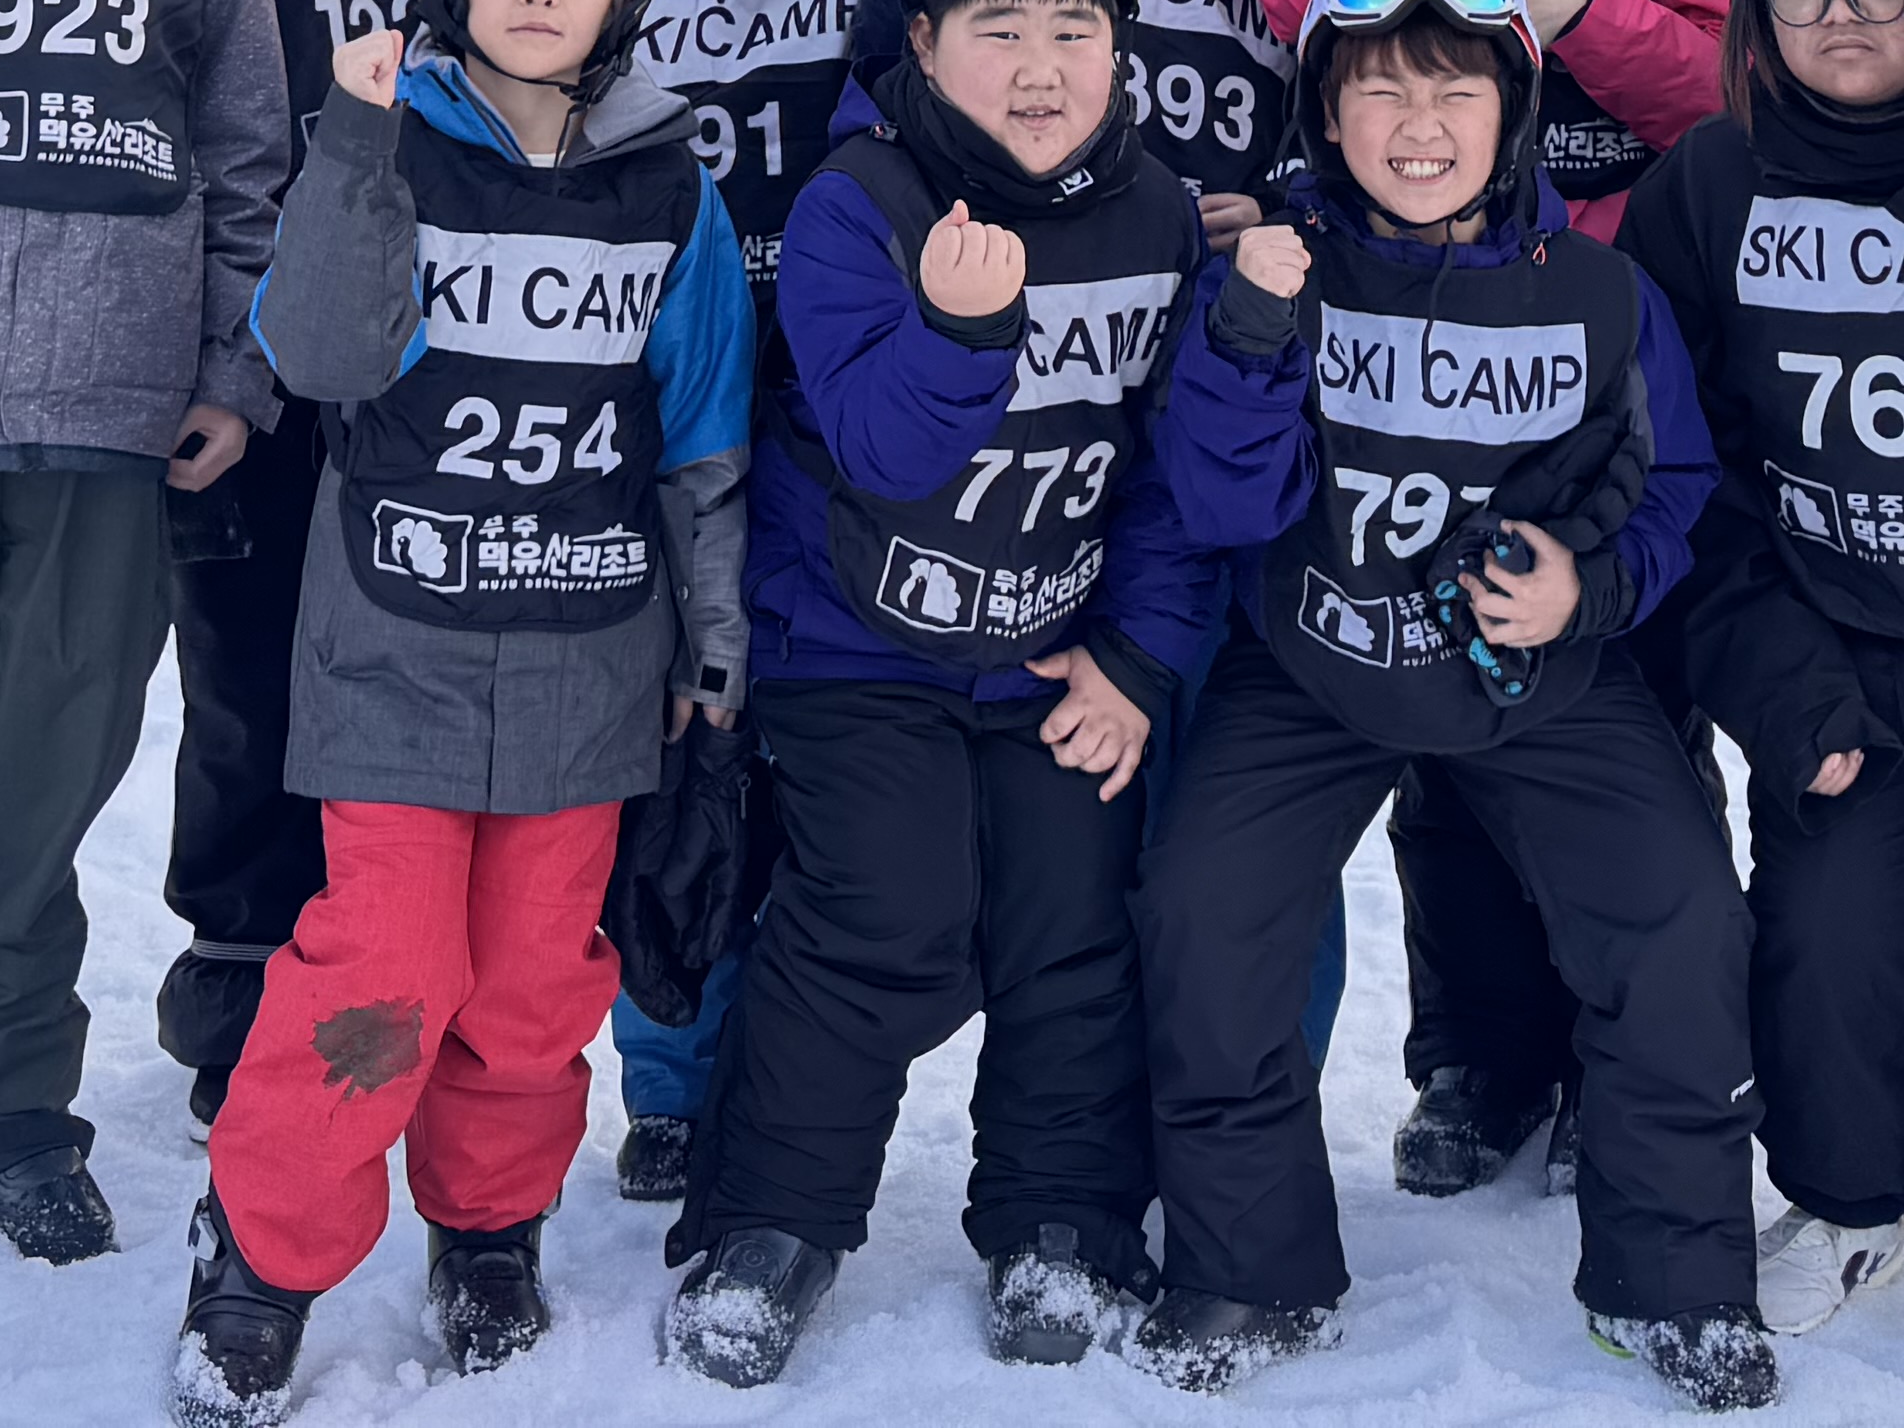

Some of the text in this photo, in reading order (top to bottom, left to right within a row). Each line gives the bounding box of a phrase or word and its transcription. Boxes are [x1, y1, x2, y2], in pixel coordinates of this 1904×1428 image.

[39, 92, 95, 120] 무주
[687, 100, 783, 182] 91
[1743, 224, 1826, 282] SKI
[422, 260, 658, 333] KI CAM
[1319, 331, 1583, 415] SKI CAMP
[435, 395, 623, 486] 254
[953, 439, 1117, 533] 773
[1334, 466, 1497, 568] 79
[1846, 493, 1904, 520] 무주
[477, 514, 539, 540] 무주
